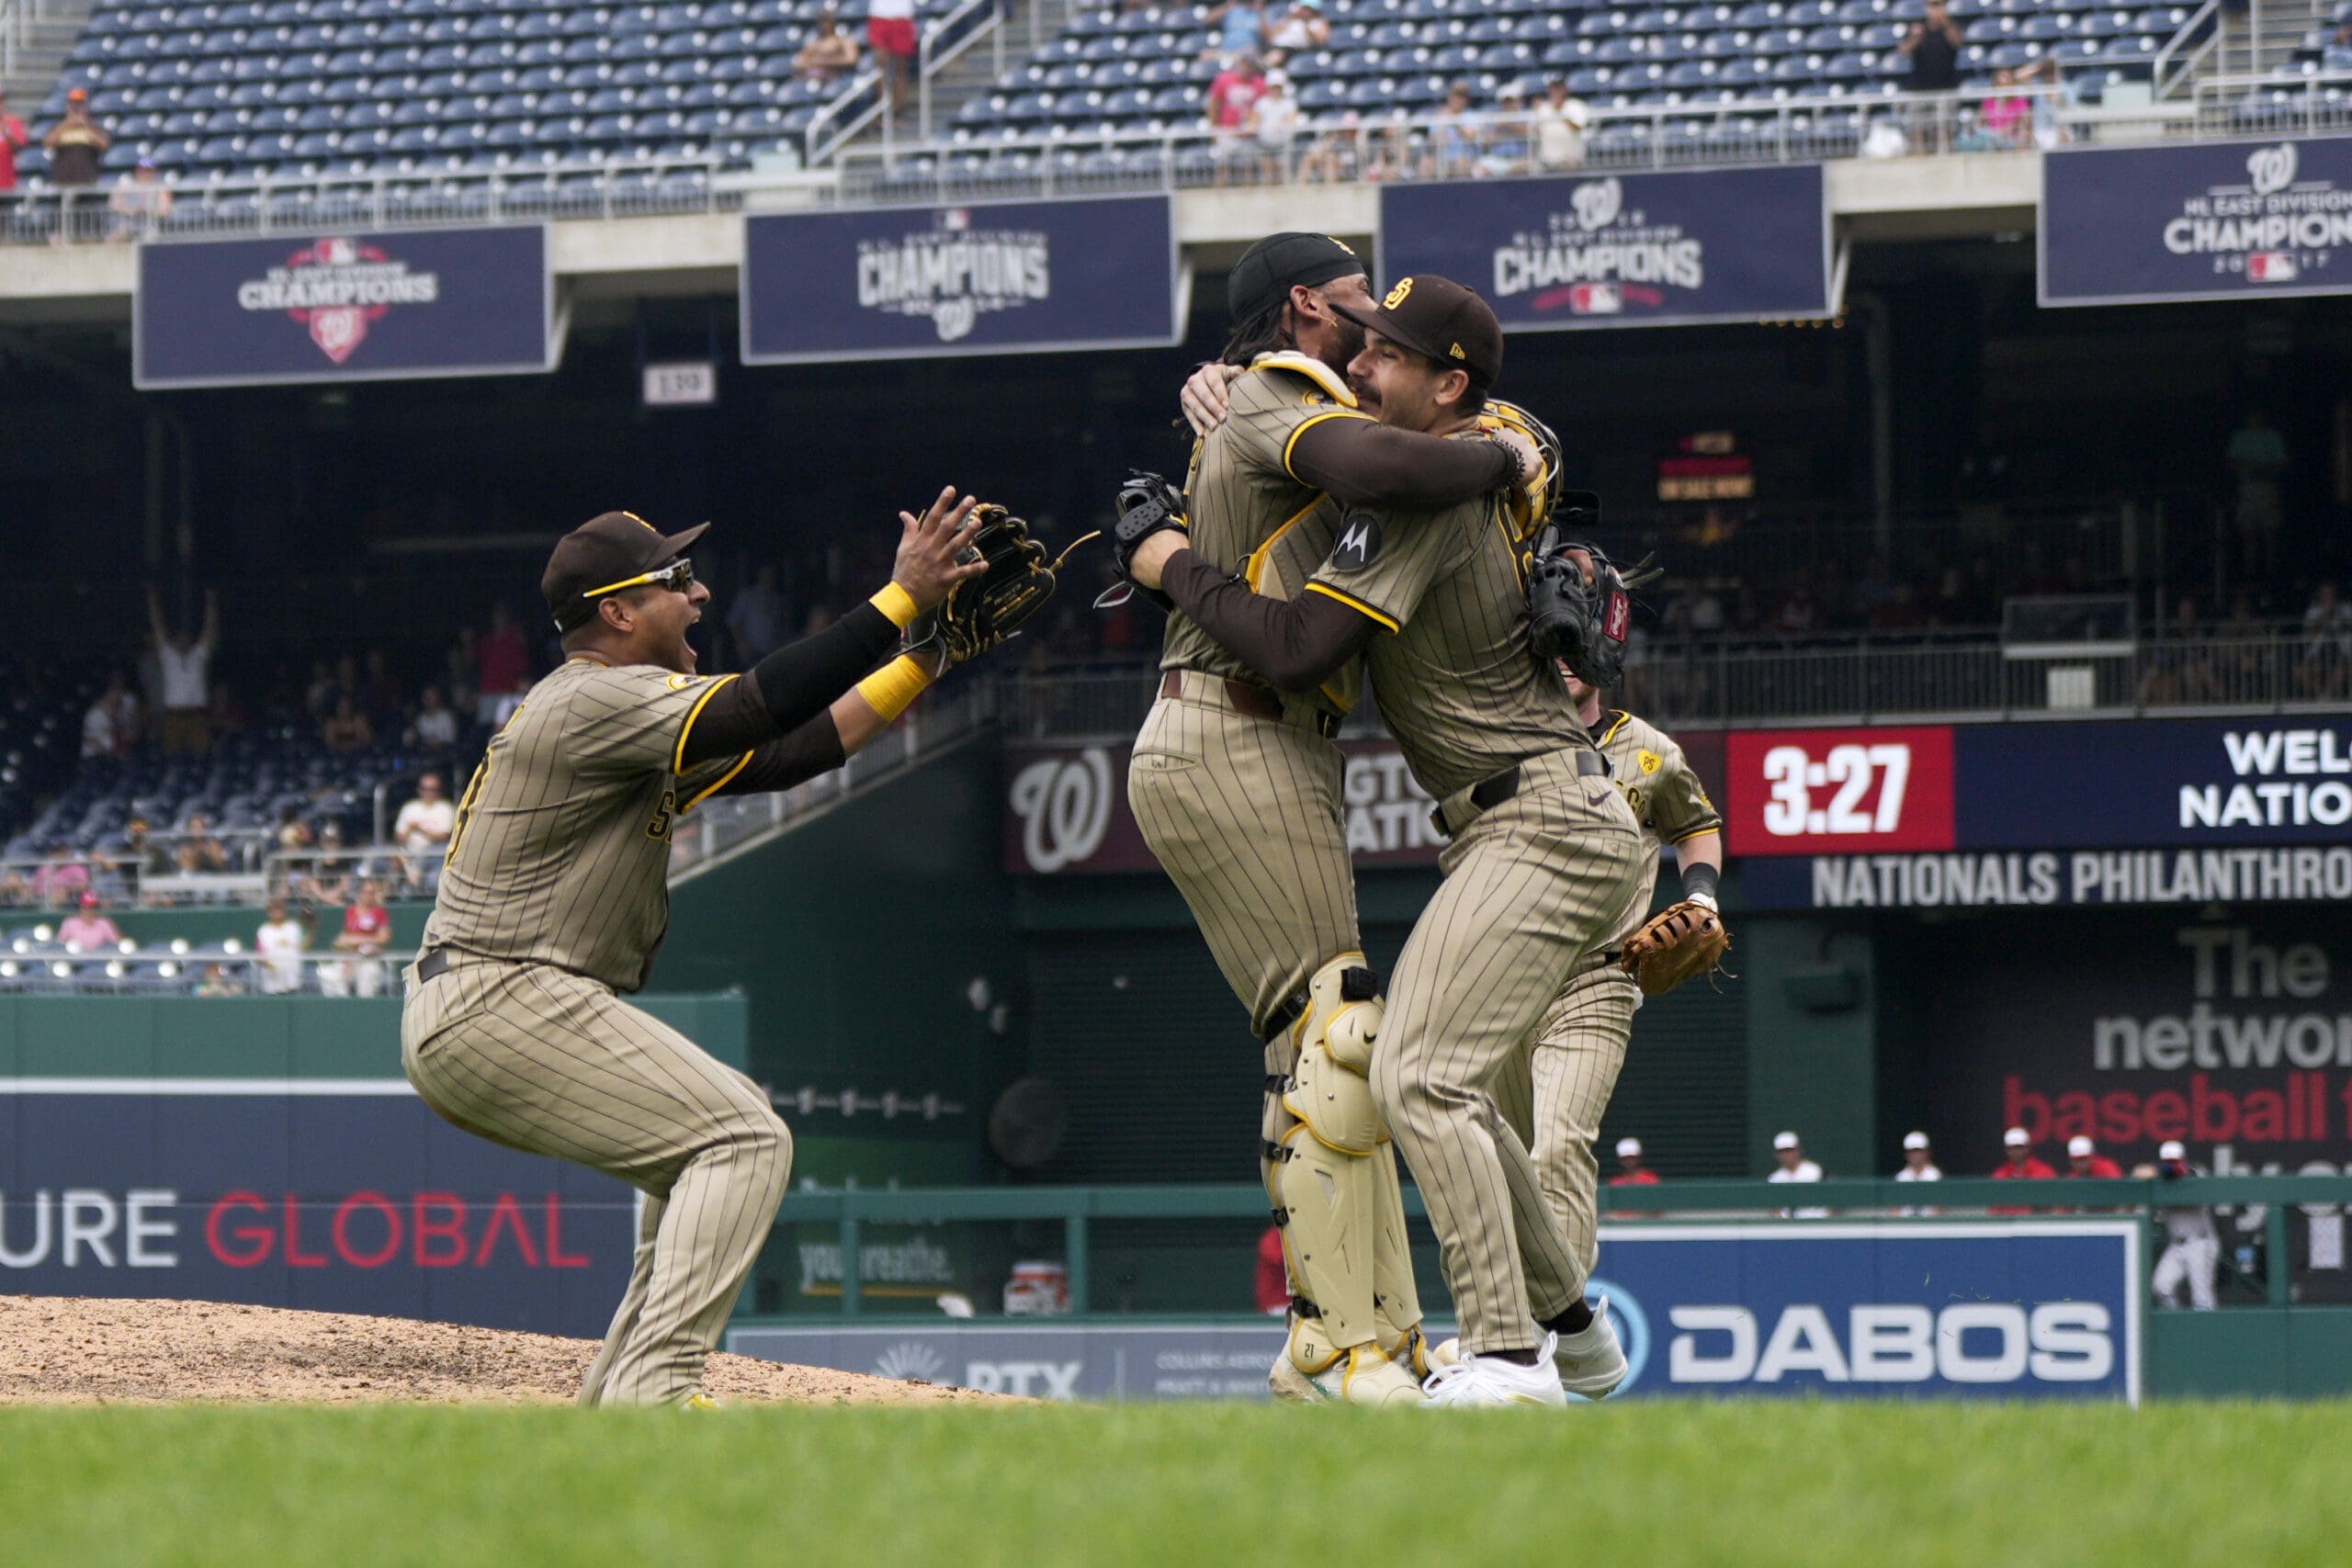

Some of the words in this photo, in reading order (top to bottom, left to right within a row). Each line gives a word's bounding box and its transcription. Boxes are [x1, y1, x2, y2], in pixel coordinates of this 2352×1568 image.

[2163, 210, 2352, 254] CHAMPION
[2213, 193, 2261, 216] EAST
[237, 271, 439, 310] CHAMPIONS
[857, 243, 1050, 308] CHAMPIONS
[1493, 238, 1702, 298] CHAMPIONS
[1643, 755, 1655, 772] PS
[2223, 728, 2352, 776] WEL
[1762, 742, 1912, 837] 3:27
[2178, 780, 2352, 829] NATIO
[1811, 852, 2060, 908] NATIONALS
[2071, 845, 2352, 905] PHILANTHRO
[2178, 928, 2330, 998] The
[2002, 1071, 2328, 1144] baseball
[0, 1189, 178, 1269] URE
[1668, 1302, 2114, 1383] DABOS
